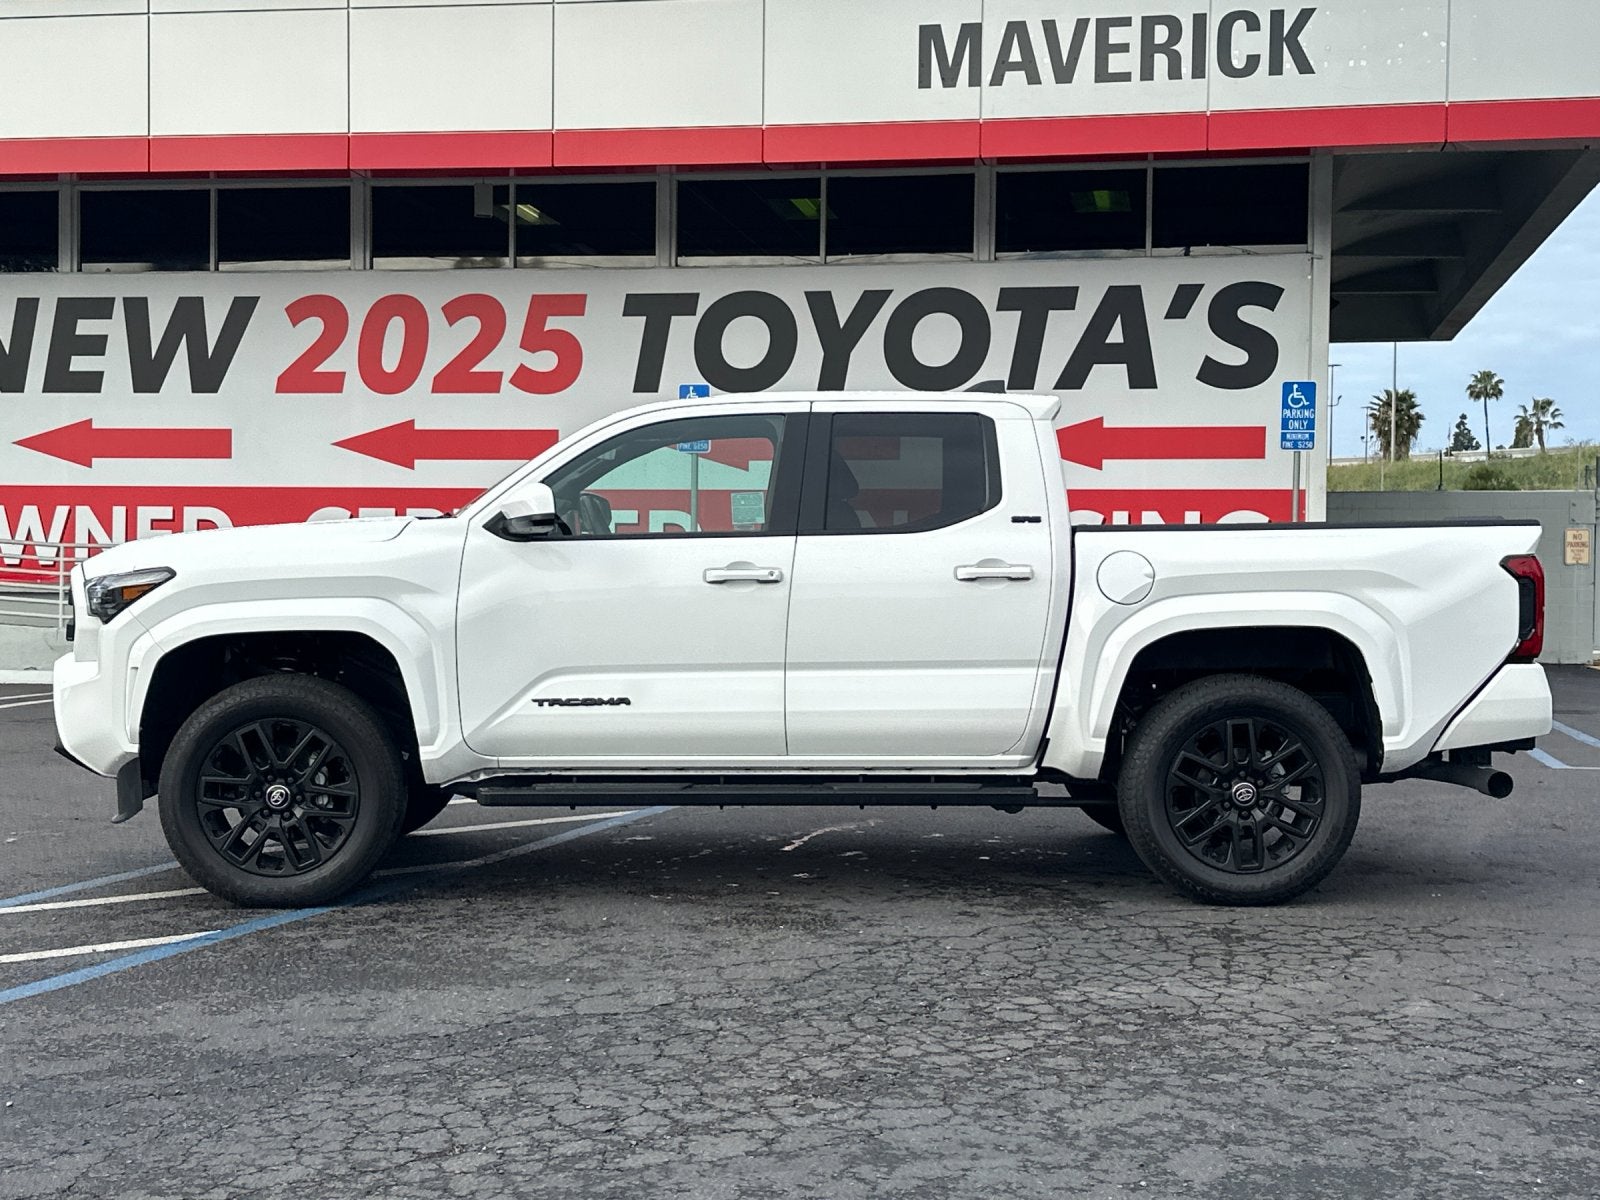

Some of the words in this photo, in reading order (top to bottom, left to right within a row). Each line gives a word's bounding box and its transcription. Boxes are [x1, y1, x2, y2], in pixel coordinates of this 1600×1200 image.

[917, 7, 1318, 90] MAVERICK
[0, 296, 261, 394] NEW
[275, 293, 588, 395] 2025
[622, 281, 1285, 393] TOYOTA'S
[1283, 409, 1314, 418] PARKING
[1288, 420, 1308, 429] ONLY
[1572, 533, 1583, 541] NO
[531, 697, 631, 707] TACOMA
